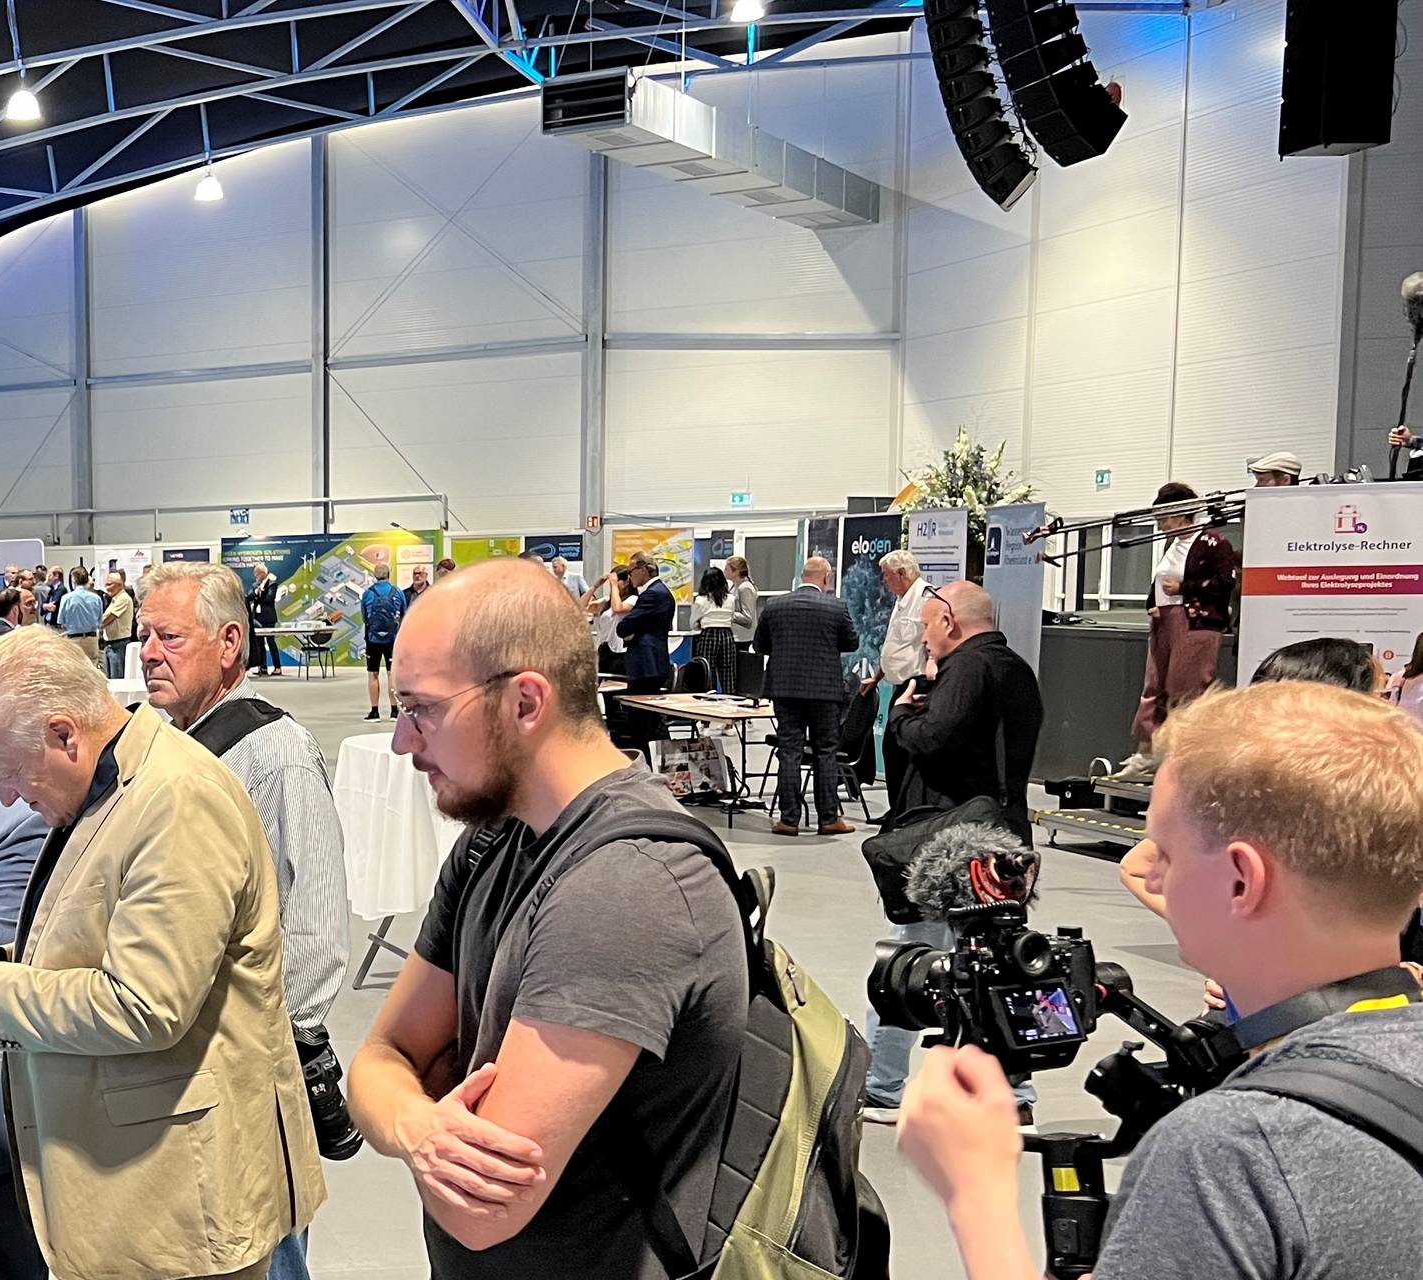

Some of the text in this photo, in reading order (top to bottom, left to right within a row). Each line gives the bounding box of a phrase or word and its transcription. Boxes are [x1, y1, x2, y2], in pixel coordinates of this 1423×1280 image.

[851, 536, 892, 560] elogen
[1287, 540, 1412, 552] Elektrolyse-Rechner
[1376, 573, 1419, 581] Einordnung
[1320, 581, 1393, 589] Elektrolyseprojektes
